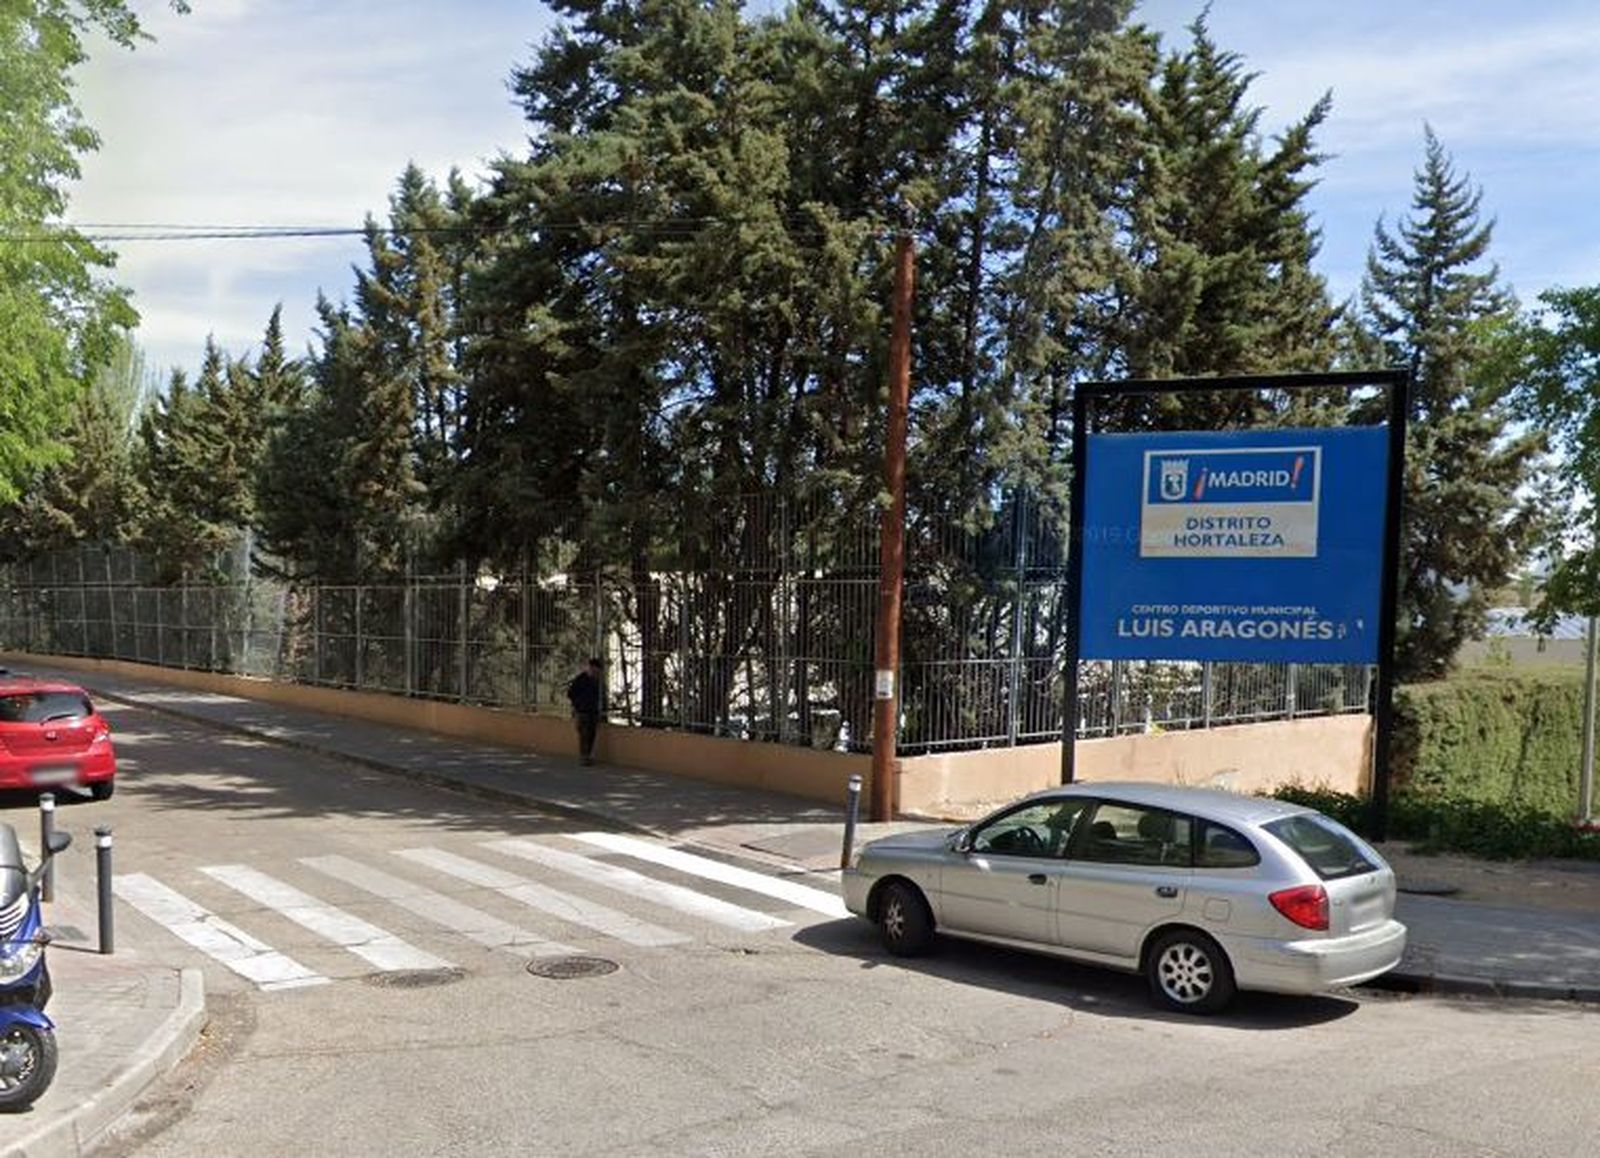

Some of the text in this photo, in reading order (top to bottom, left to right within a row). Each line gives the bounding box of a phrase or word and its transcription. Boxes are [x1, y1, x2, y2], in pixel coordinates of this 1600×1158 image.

[1193, 456, 1305, 501] ¡MADRID!
[1185, 516, 1272, 531] DISTRITO
[1173, 532, 1286, 548] HORTALEZA
[1131, 604, 1319, 616] CENTRO DEPORTIVO MUNICIPAL
[1117, 618, 1175, 638] LUIS
[1180, 615, 1334, 640] ARAGONÉS
